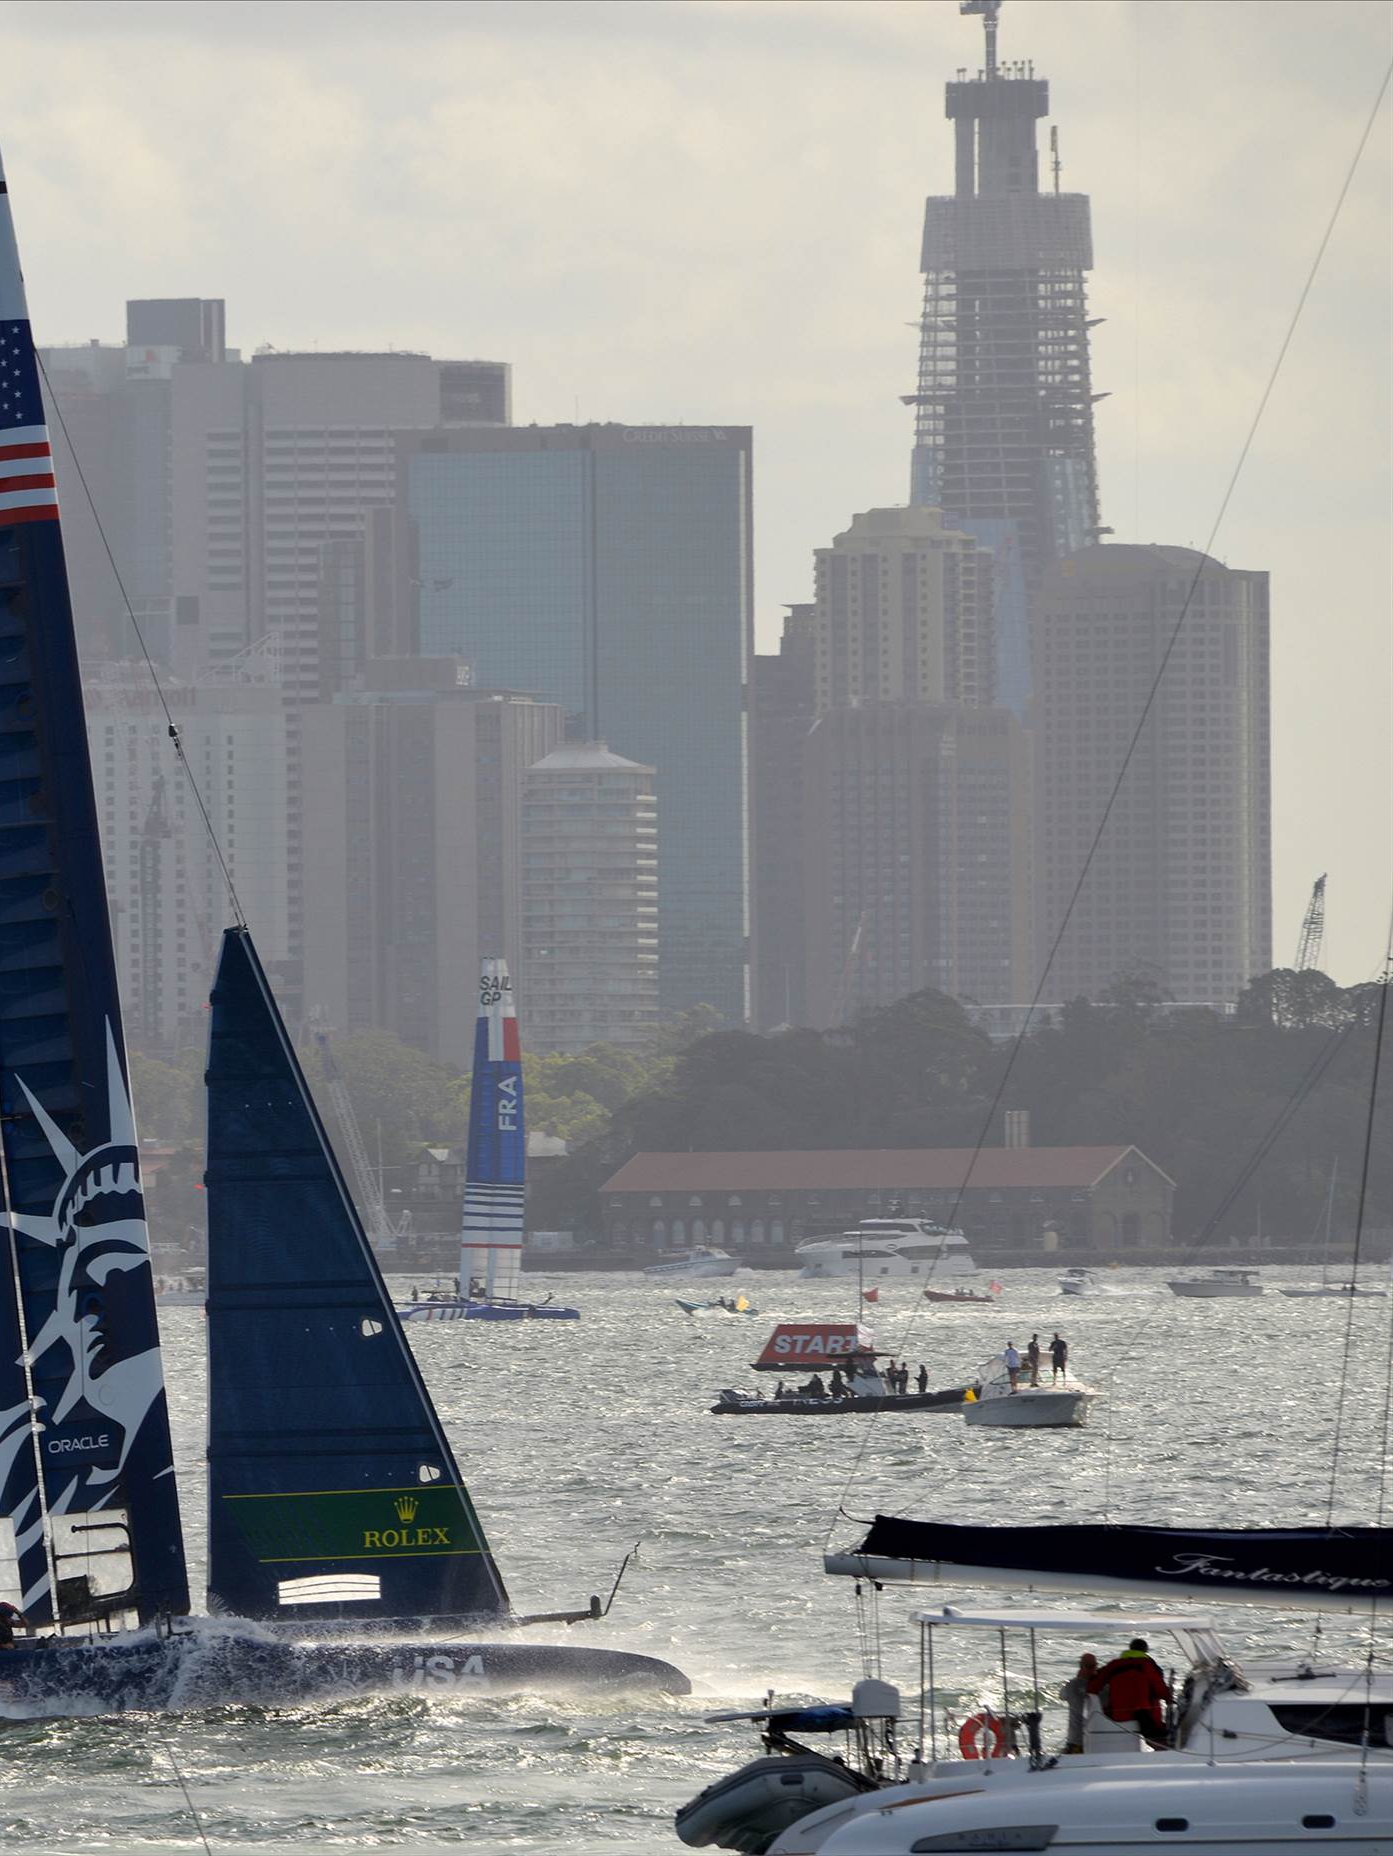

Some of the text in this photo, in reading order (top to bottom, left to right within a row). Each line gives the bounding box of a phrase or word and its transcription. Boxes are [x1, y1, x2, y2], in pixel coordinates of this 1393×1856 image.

[479, 975, 513, 991] SAIL
[480, 991, 502, 1006] GP
[498, 1075, 517, 1131] FRA
[774, 1335, 858, 1354] START
[48, 1434, 109, 1454] ORACLE
[363, 1527, 452, 1548] ROLEX
[1155, 1553, 1392, 1590] Fantastique
[392, 1655, 490, 1692] USA
